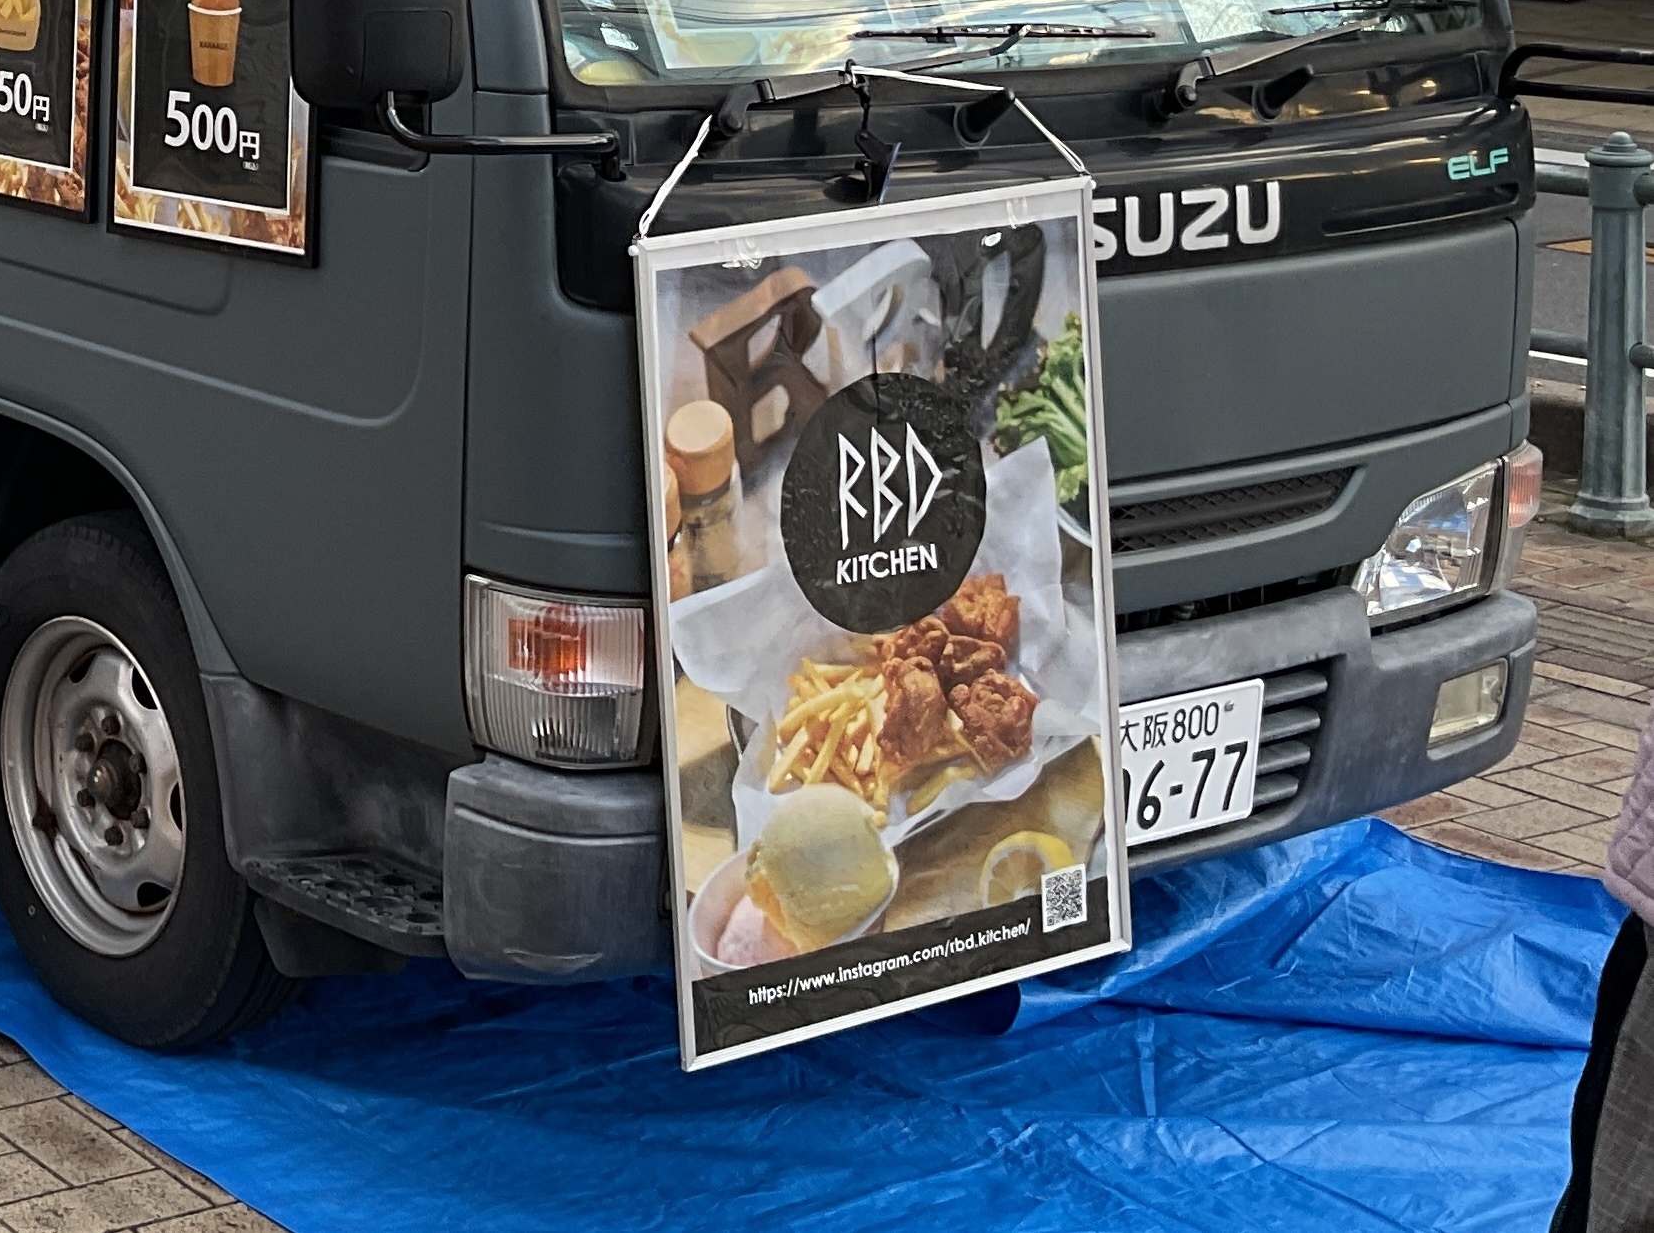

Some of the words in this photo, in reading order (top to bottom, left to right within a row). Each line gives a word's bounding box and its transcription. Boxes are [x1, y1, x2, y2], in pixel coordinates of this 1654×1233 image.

[164, 89, 260, 160] 500円
[1448, 147, 1509, 182] ELF
[1092, 180, 1281, 261] SUZU
[837, 421, 943, 551] RBD
[836, 543, 938, 585] KITCHEN
[748, 917, 1032, 1005] https://www.instagram.com/rbd.kitchen/
